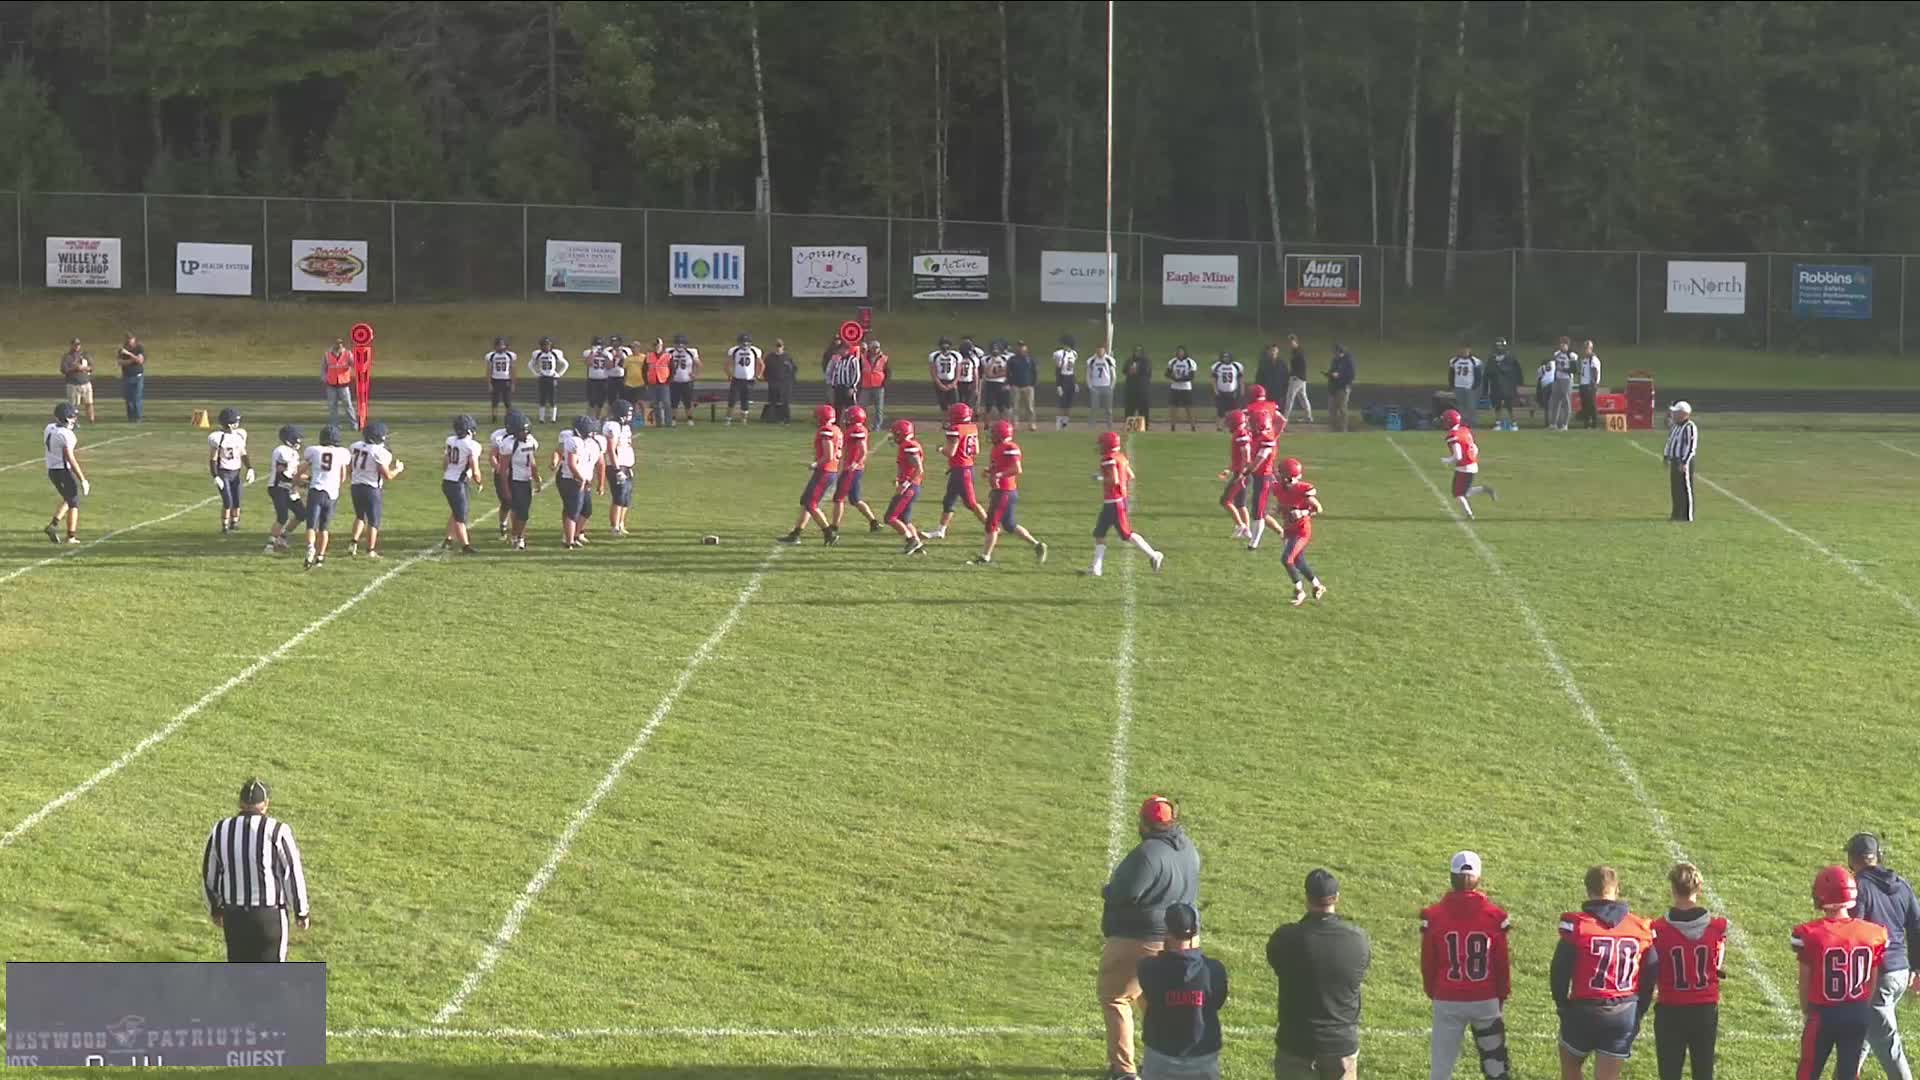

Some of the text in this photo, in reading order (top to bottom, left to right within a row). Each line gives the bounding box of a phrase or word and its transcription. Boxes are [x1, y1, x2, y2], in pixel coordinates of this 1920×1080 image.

[57, 253, 108, 264] WILLEY'S
[796, 250, 863, 264] Congress
[85, 264, 109, 274] SHOP
[180, 260, 200, 275] UP
[674, 251, 738, 280] Holli
[1305, 260, 1342, 273] Auto
[805, 276, 855, 289] Pizzas
[1166, 271, 1234, 285] Eagle Mine
[1302, 274, 1343, 288] Value
[1800, 271, 1852, 284] Robbins
[738, 357, 751, 367] 40
[1609, 415, 1625, 430] 40
[321, 452, 333, 471] 9
[352, 447, 368, 469] 77
[1444, 930, 1490, 982] 18
[1589, 936, 1641, 992] 70
[1670, 945, 1709, 991] 11
[1822, 946, 1873, 1001] 60
